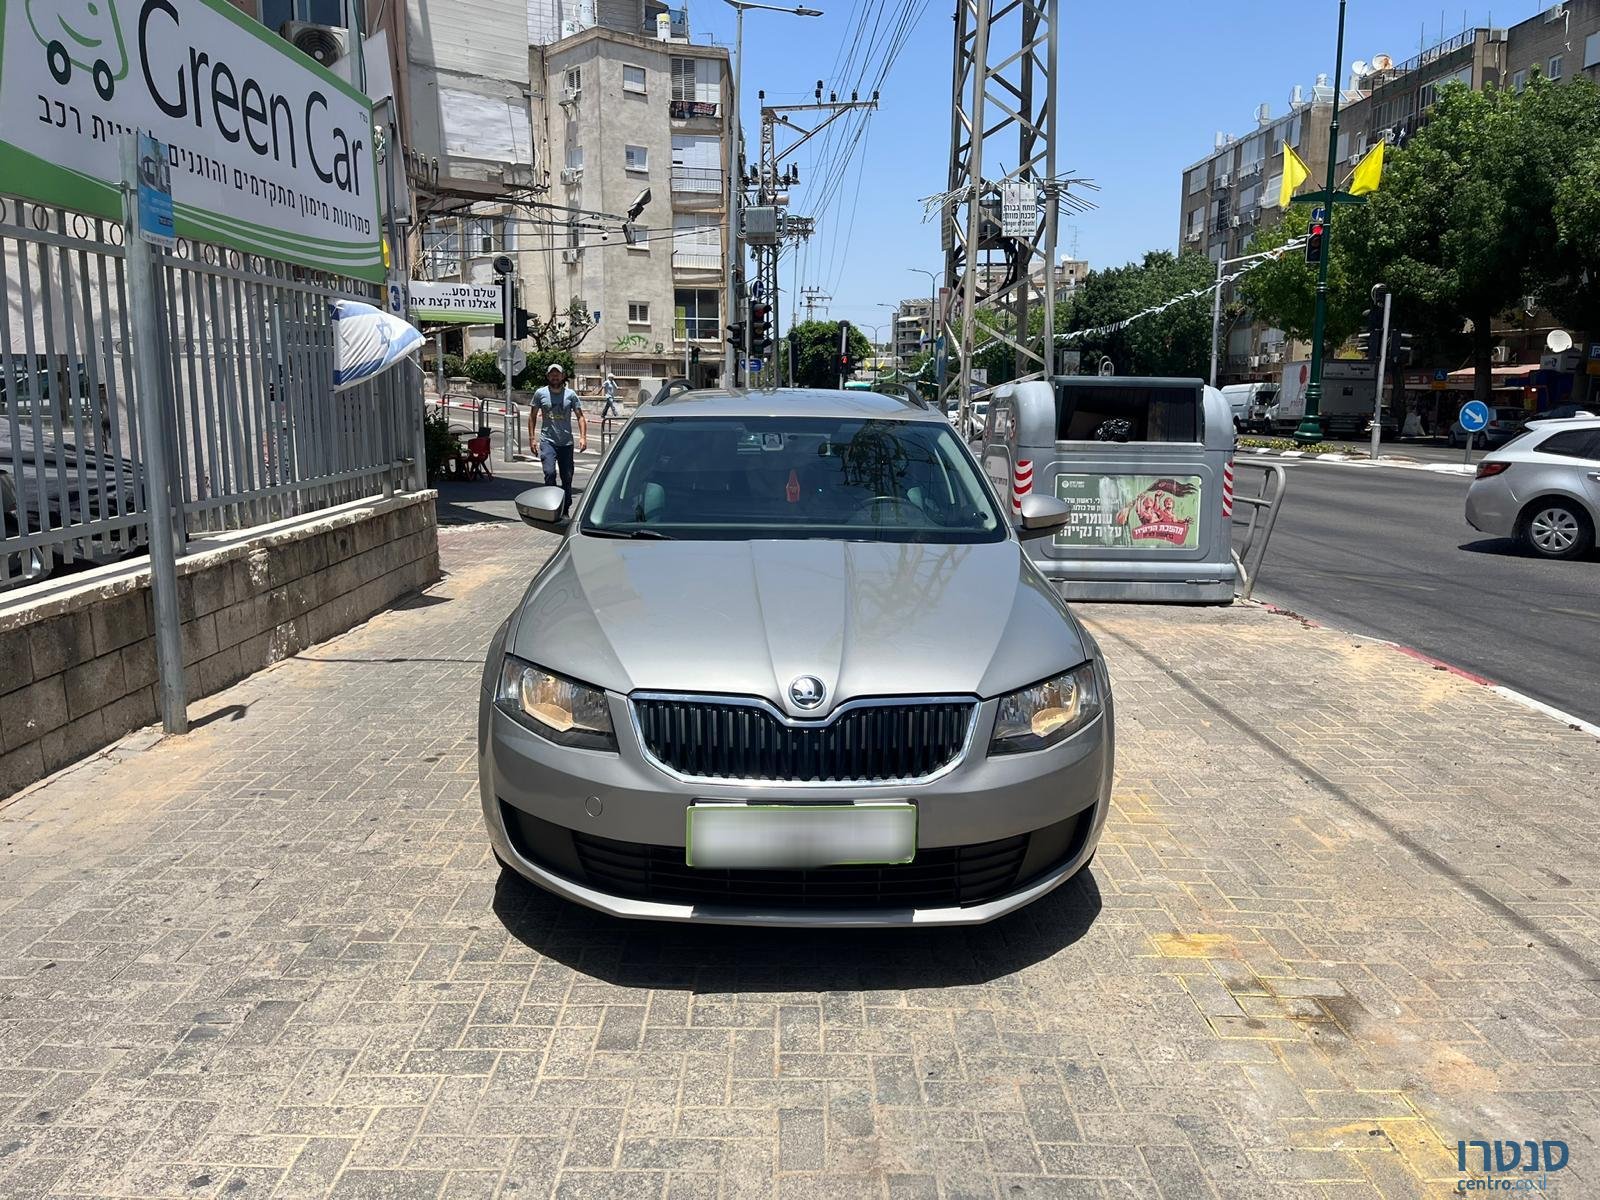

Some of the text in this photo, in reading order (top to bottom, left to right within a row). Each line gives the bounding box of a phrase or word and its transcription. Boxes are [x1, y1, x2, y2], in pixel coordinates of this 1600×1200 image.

[138, 0, 363, 196] Green Car
[38, 94, 82, 134] רכב
[168, 143, 228, 185] והוגנים
[233, 168, 296, 208] מתקדמים
[300, 193, 330, 220] מימון
[332, 206, 371, 235] פתרונות
[410, 296, 497, 309] אצלנו זה קצת אח
[441, 287, 496, 298] שלם וסע...
[1070, 513, 1113, 524] שומרים
